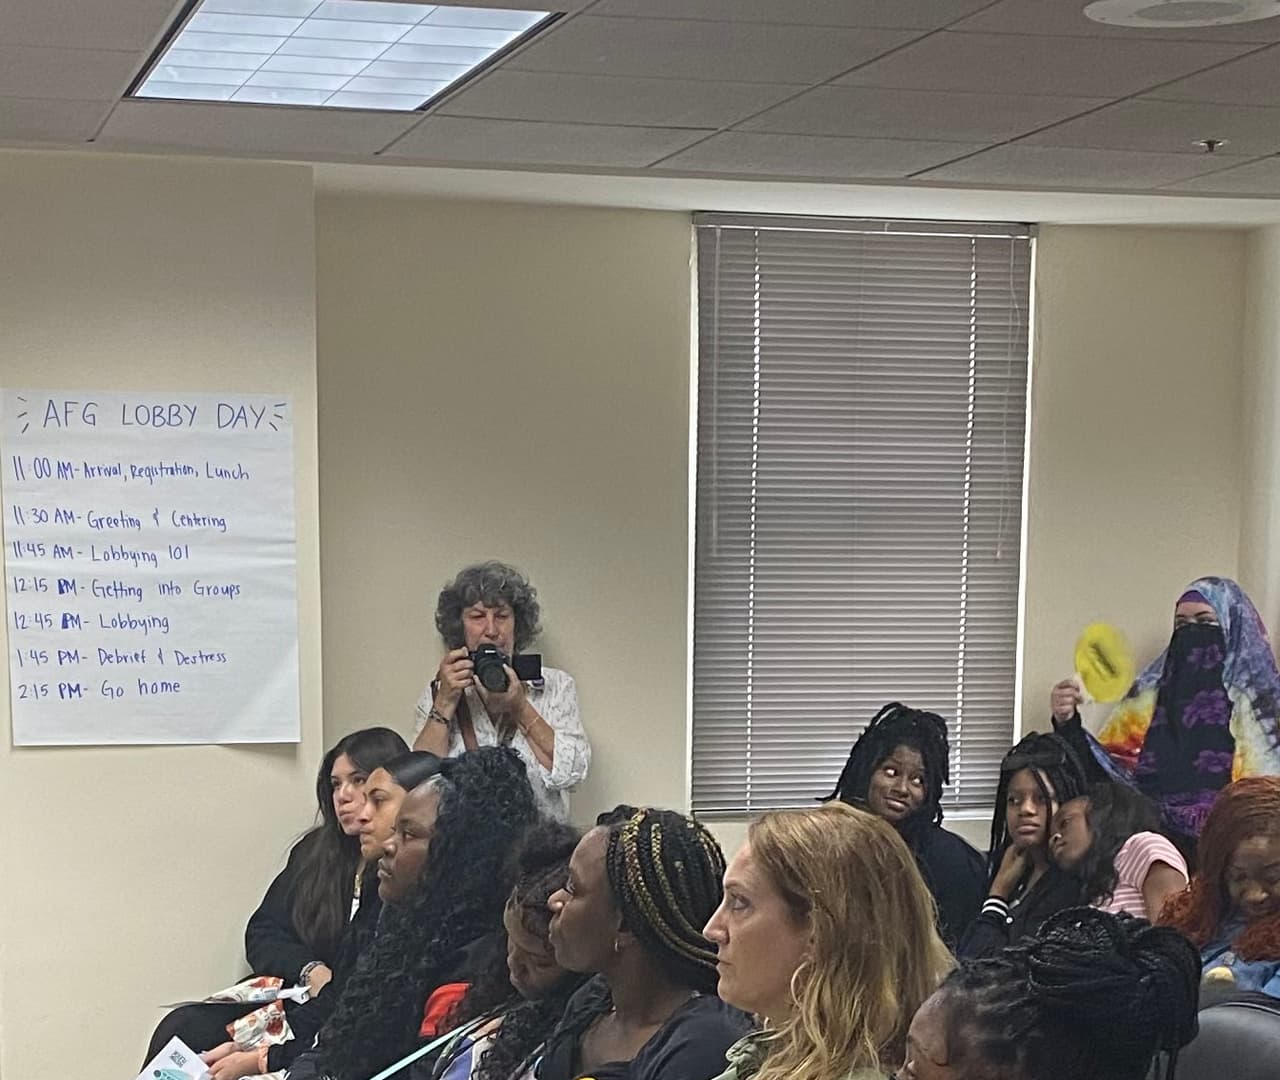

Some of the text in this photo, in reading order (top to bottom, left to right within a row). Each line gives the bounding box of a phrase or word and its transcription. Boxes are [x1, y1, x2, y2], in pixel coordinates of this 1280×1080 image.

[43, 400, 266, 429] AFG LOBBY DAY
[206, 459, 249, 481] Lunch
[87, 510, 141, 530] Greeting
[171, 510, 227, 532] Centering
[13, 541, 46, 558] 11:45
[91, 545, 158, 568] Lobbying
[169, 545, 189, 560] 101
[14, 576, 48, 593] 12:15
[92, 580, 143, 601] Getting
[158, 581, 182, 596] into
[193, 580, 241, 599] Groups
[14, 611, 53, 629] 12:45
[100, 614, 170, 635] Lobbying
[17, 649, 49, 667] 1:45
[98, 648, 147, 666] Debrief
[175, 650, 227, 666] Destress
[18, 683, 49, 699] 2:15
[101, 680, 124, 699] Go
[138, 679, 180, 695] home
